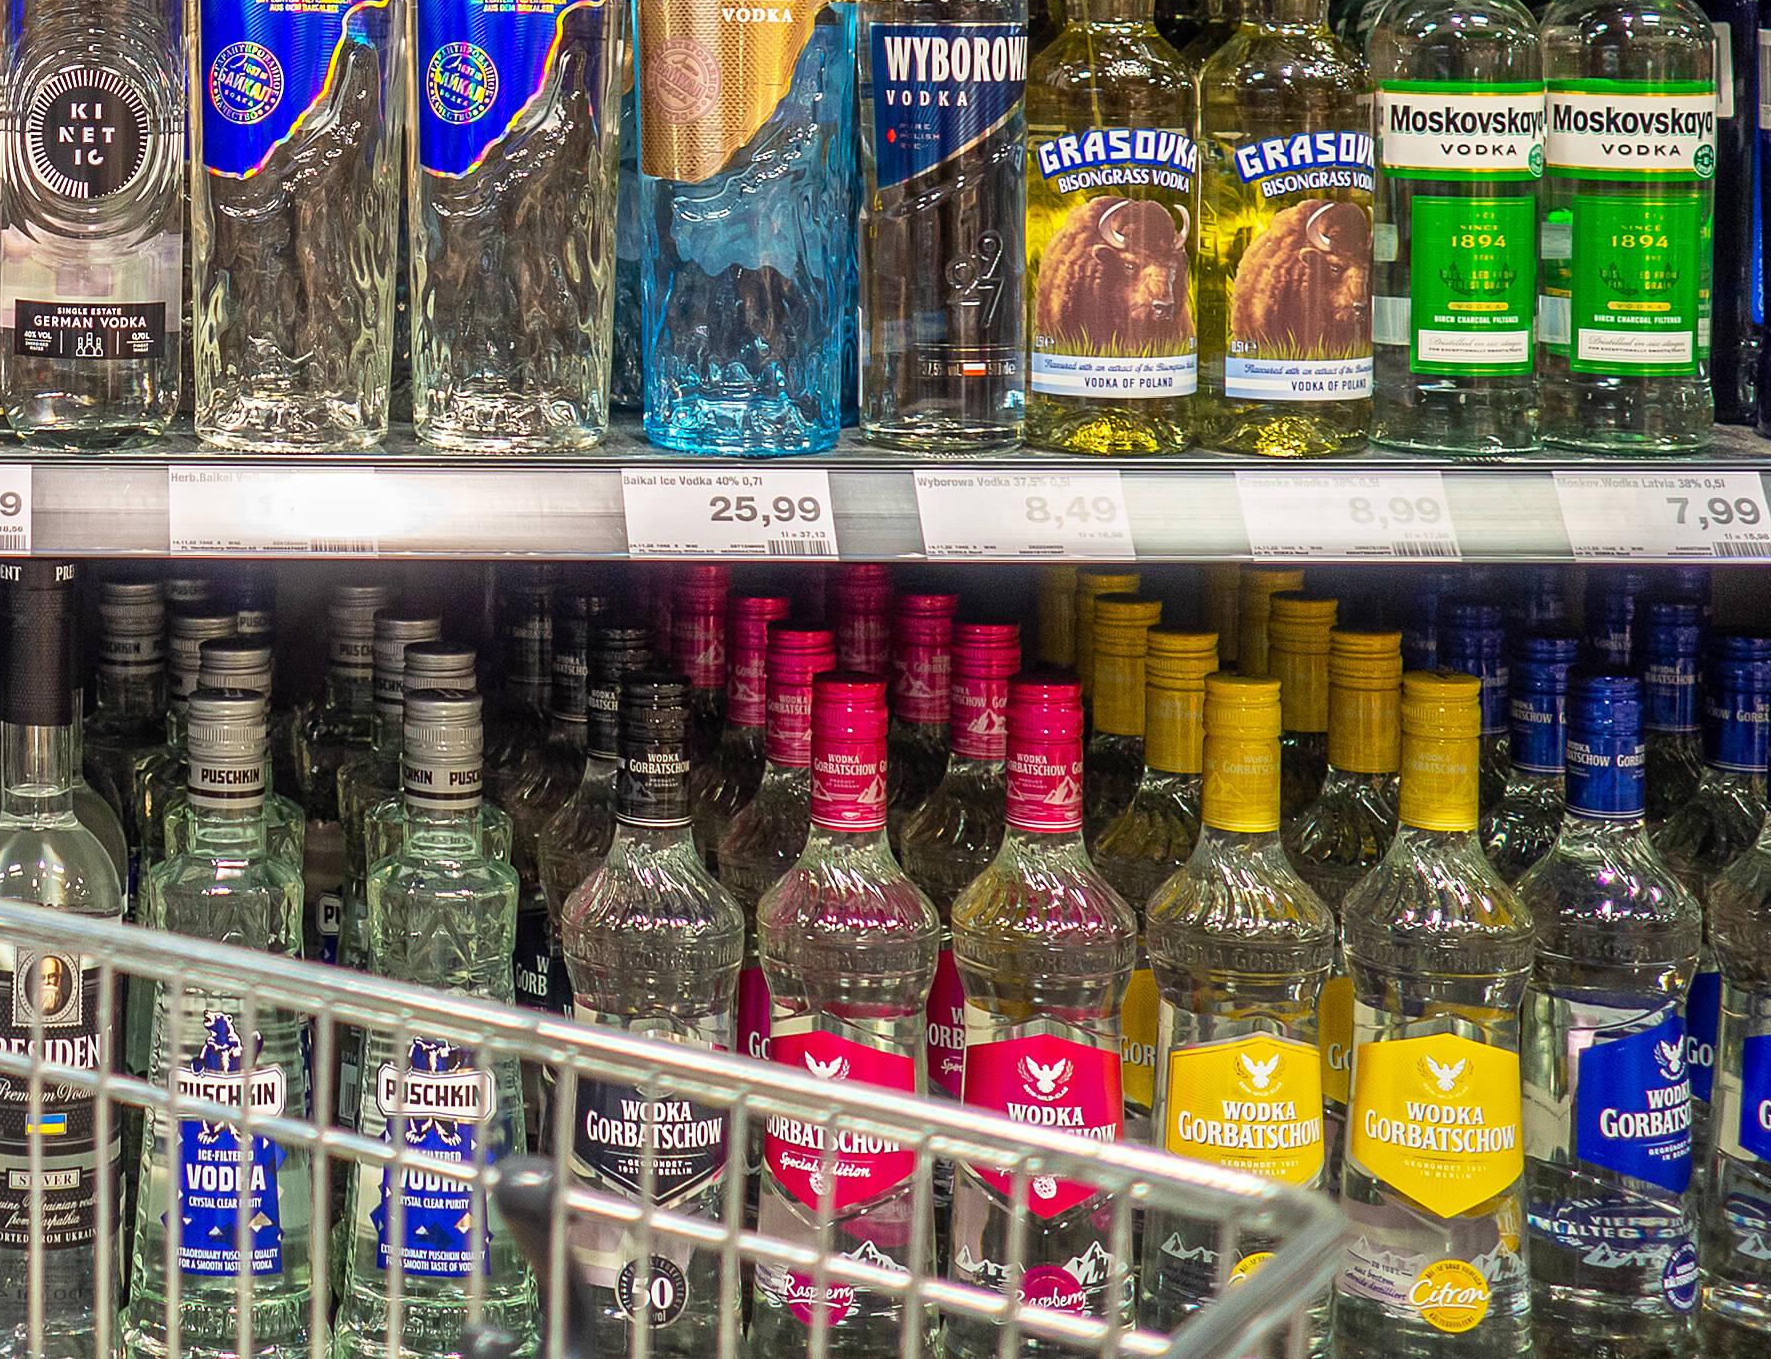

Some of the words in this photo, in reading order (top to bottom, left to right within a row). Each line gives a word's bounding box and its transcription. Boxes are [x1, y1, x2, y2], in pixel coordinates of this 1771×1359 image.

[722, 8, 793, 22] VODKA
[885, 89, 969, 107] VODKA
[1389, 104, 1543, 138] Moskovskaya
[1552, 104, 1714, 138] Moskovskaya
[1038, 129, 1196, 174] GRASOVKA
[1440, 143, 1518, 156] VODKA
[1601, 143, 1682, 157] VODKA
[1058, 169, 1150, 193] BISONGRASS
[1152, 170, 1190, 193] VODKA
[1450, 234, 1507, 249] 1894
[34, 314, 93, 329] GERMAN
[98, 315, 147, 329] VODKA
[57, 307, 87, 316] SINGLE
[90, 307, 122, 316] ESTATE
[1084, 376, 1120, 389] VODKA
[1123, 376, 1135, 389] OF
[1139, 376, 1174, 389] POLAND
[709, 495, 821, 529] 25,99
[1025, 495, 1118, 529] 8,49
[1348, 496, 1442, 529] 8,99
[1665, 496, 1761, 530] 7,99
[813, 759, 877, 776] GORBATSCHOW
[827, 754, 861, 764] WODKA
[201, 767, 260, 785] PUSCHKIN
[1221, 1100, 1297, 1123] WODKA
[1405, 1101, 1485, 1126] WODKA
[1177, 1109, 1322, 1151] GORBATSCHOW
[1365, 1110, 1515, 1154] GORBATSCHOW
[1409, 1279, 1491, 1309] Citron
